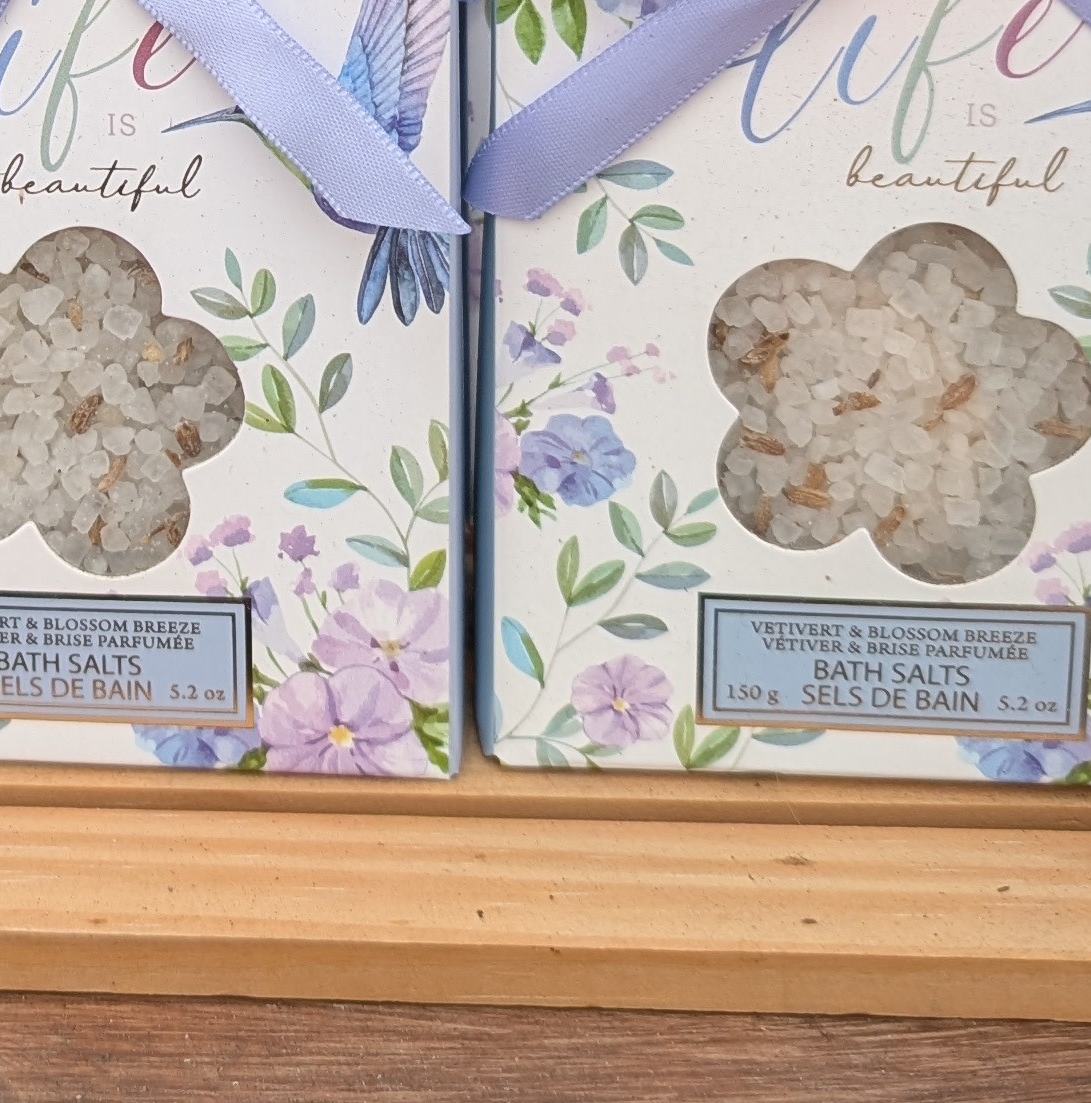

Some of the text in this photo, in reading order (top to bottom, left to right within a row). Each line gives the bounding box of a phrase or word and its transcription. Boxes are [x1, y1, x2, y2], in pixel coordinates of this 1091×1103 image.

[107, 113, 136, 137] IS
[966, 102, 997, 127] IS
[0, 153, 203, 212] beautiful
[845, 144, 1069, 207] beautiful
[26, 618, 38, 629] &
[43, 617, 128, 633] BLOSSOM
[133, 620, 201, 635] BREEZE
[751, 621, 1037, 645] VETIVERT & BLOSSOM BREEZE
[26, 633, 38, 645] &
[43, 633, 93, 647] BRISE
[98, 634, 195, 650] PARFUMÉE
[762, 636, 1029, 660] VÉTIVER & BRISE PARFUMÉE
[69, 653, 142, 676] SALTS
[813, 659, 970, 687] BATH SALTS
[51, 677, 85, 699] DE
[93, 679, 152, 701] BAIN
[169, 683, 199, 700] 5.2
[204, 688, 226, 701] oz
[726, 684, 1057, 713] 150 g SELS DE BAIN 5.2 oz
